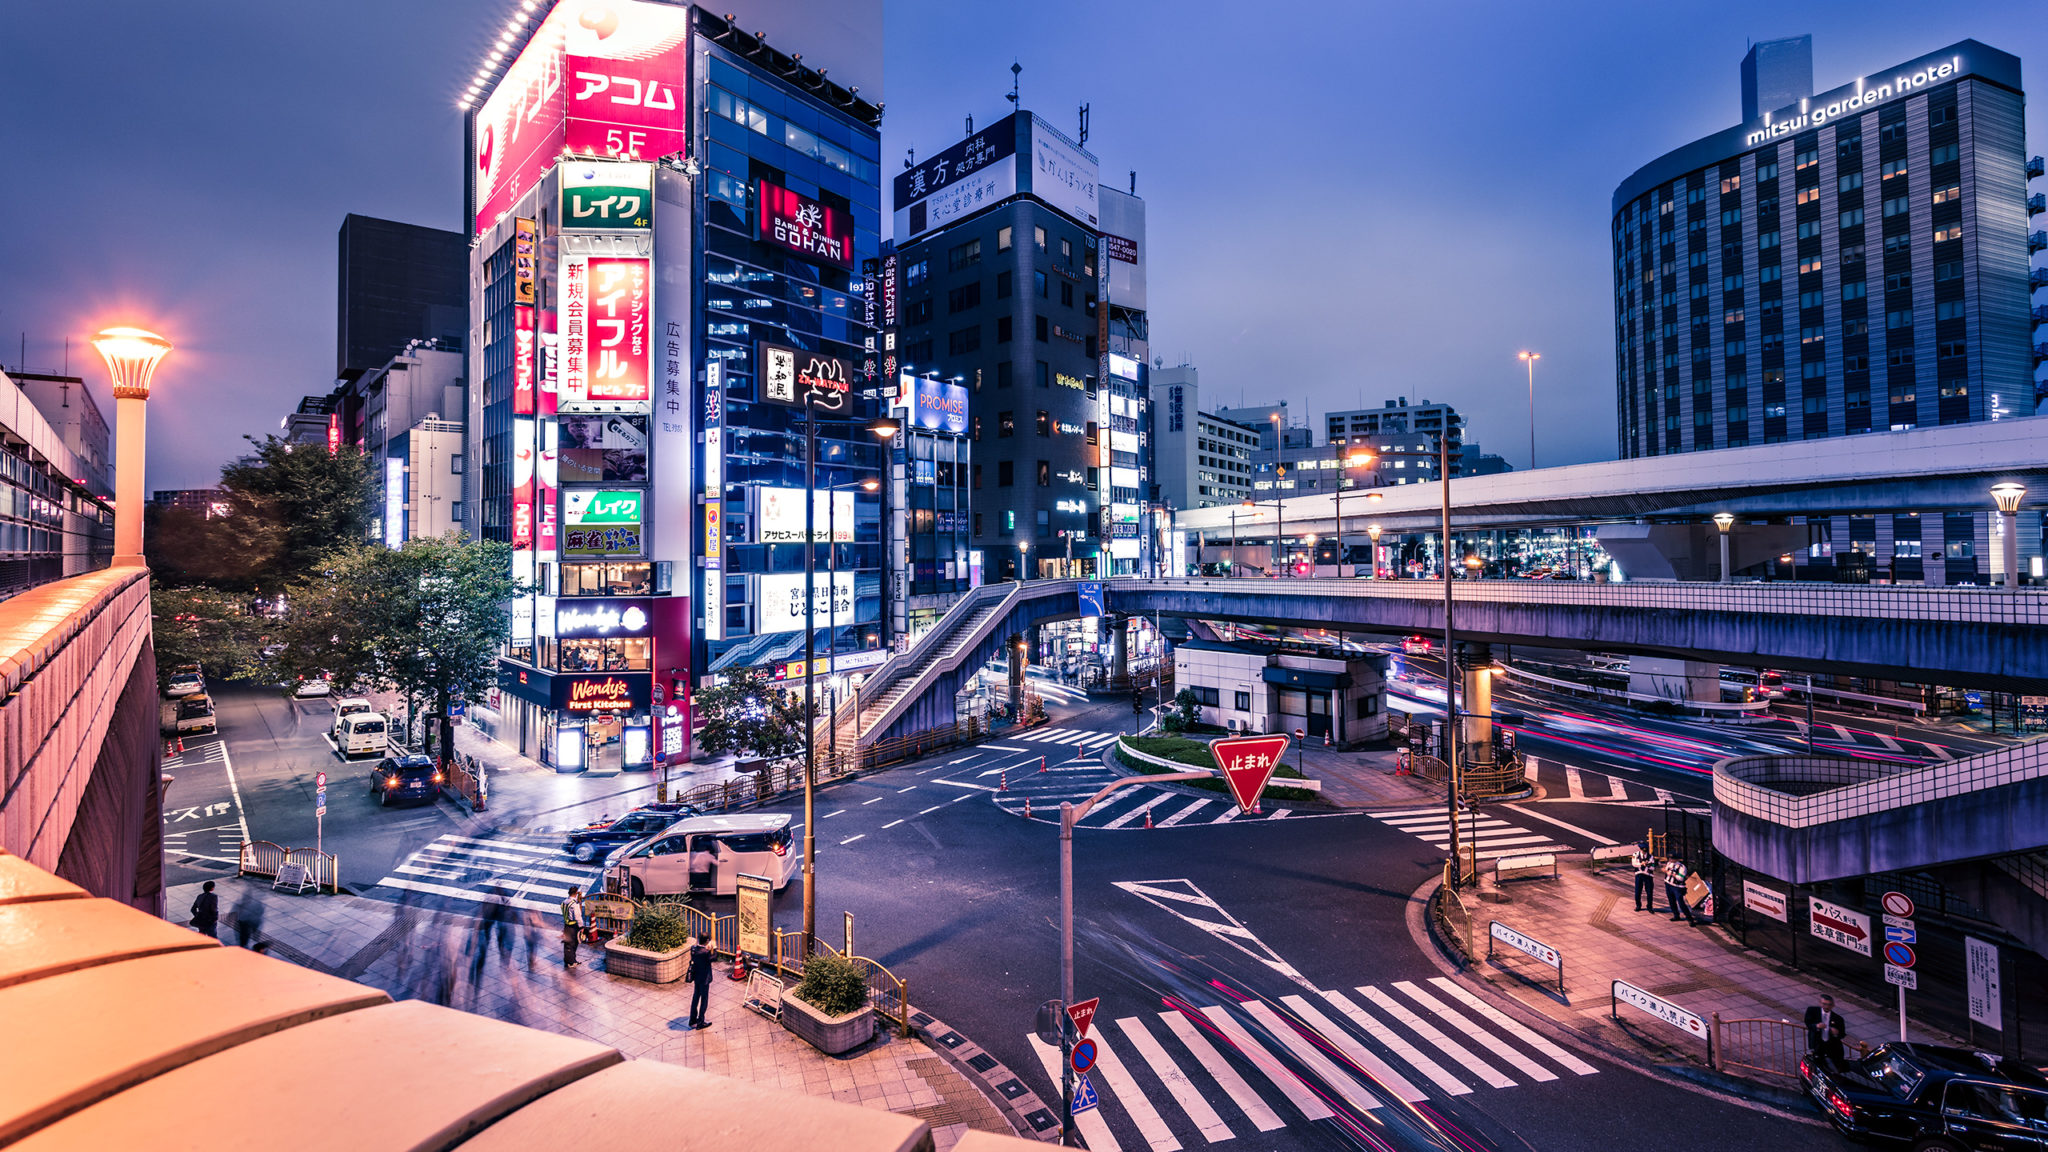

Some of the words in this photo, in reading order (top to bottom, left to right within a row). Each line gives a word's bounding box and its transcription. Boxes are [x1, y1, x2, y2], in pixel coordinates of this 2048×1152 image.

[576, 71, 676, 110] アコム
[1747, 97, 1808, 146] mitsui
[1811, 77, 1891, 126] garden
[1896, 57, 1960, 93] hotel
[606, 129, 647, 154] 5F
[965, 137, 985, 156] 内科
[909, 158, 950, 198] 漢方
[572, 195, 641, 218] レイク
[633, 218, 648, 227] 4F
[775, 217, 799, 232] BARU
[813, 231, 841, 248] DINING
[775, 226, 841, 261] GOHAN
[596, 264, 628, 378] アイフル
[631, 266, 643, 356] キャッシングなら
[567, 263, 584, 392] 新規会員募集中
[666, 321, 681, 414] 広告募集中
[920, 393, 963, 414] PROMISE
[516, 503, 530, 536] アコム
[595, 500, 637, 514] レイク
[566, 529, 605, 550] 麻雀
[572, 677, 627, 700] Wendy's
[569, 701, 592, 709] First
[593, 701, 631, 709] Kitchen
[1229, 753, 1271, 771] 止まれ
[1813, 922, 1869, 953] 浅草雷門方面
[1074, 1007, 1093, 1020] 止まれ
[1621, 988, 1687, 1025] バイク進入禁止
